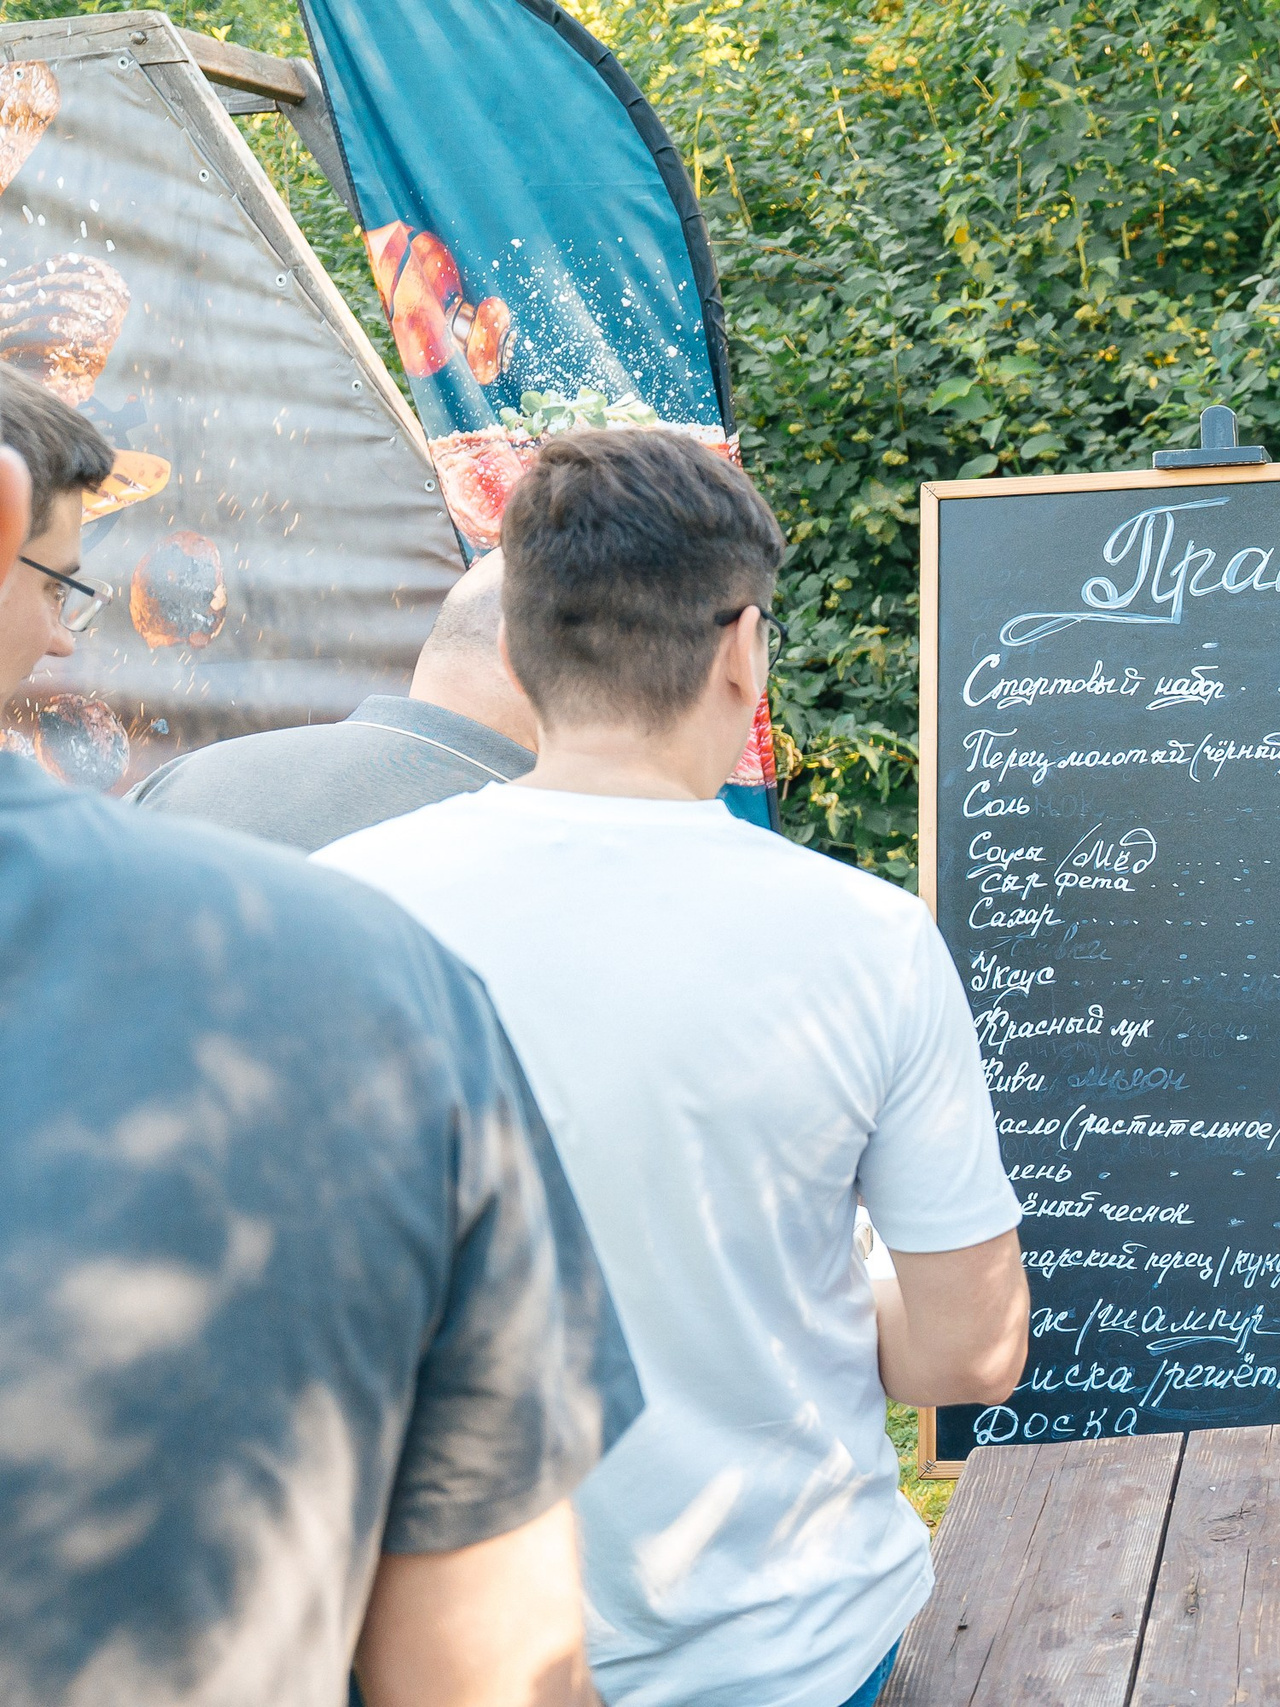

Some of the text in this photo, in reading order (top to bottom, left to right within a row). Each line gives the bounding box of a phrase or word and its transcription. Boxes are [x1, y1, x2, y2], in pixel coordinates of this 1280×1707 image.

[963, 653, 1146, 709] Стартовый
[1146, 665, 1226, 710] набор
[963, 728, 1056, 786] Перец
[963, 779, 1031, 818] Соль
[966, 831, 1047, 880] Соусы
[968, 897, 1062, 936] Сахар
[970, 950, 1057, 1005] Уксус
[974, 1005, 1104, 1055] Красный
[1110, 1018, 1155, 1047] лук
[994, 1111, 1061, 1135] асло
[1007, 1164, 1072, 1182] лень
[1020, 1192, 1102, 1217] ёный
[1098, 1203, 1195, 1224] чеснок
[973, 1405, 1138, 1445] Доска
